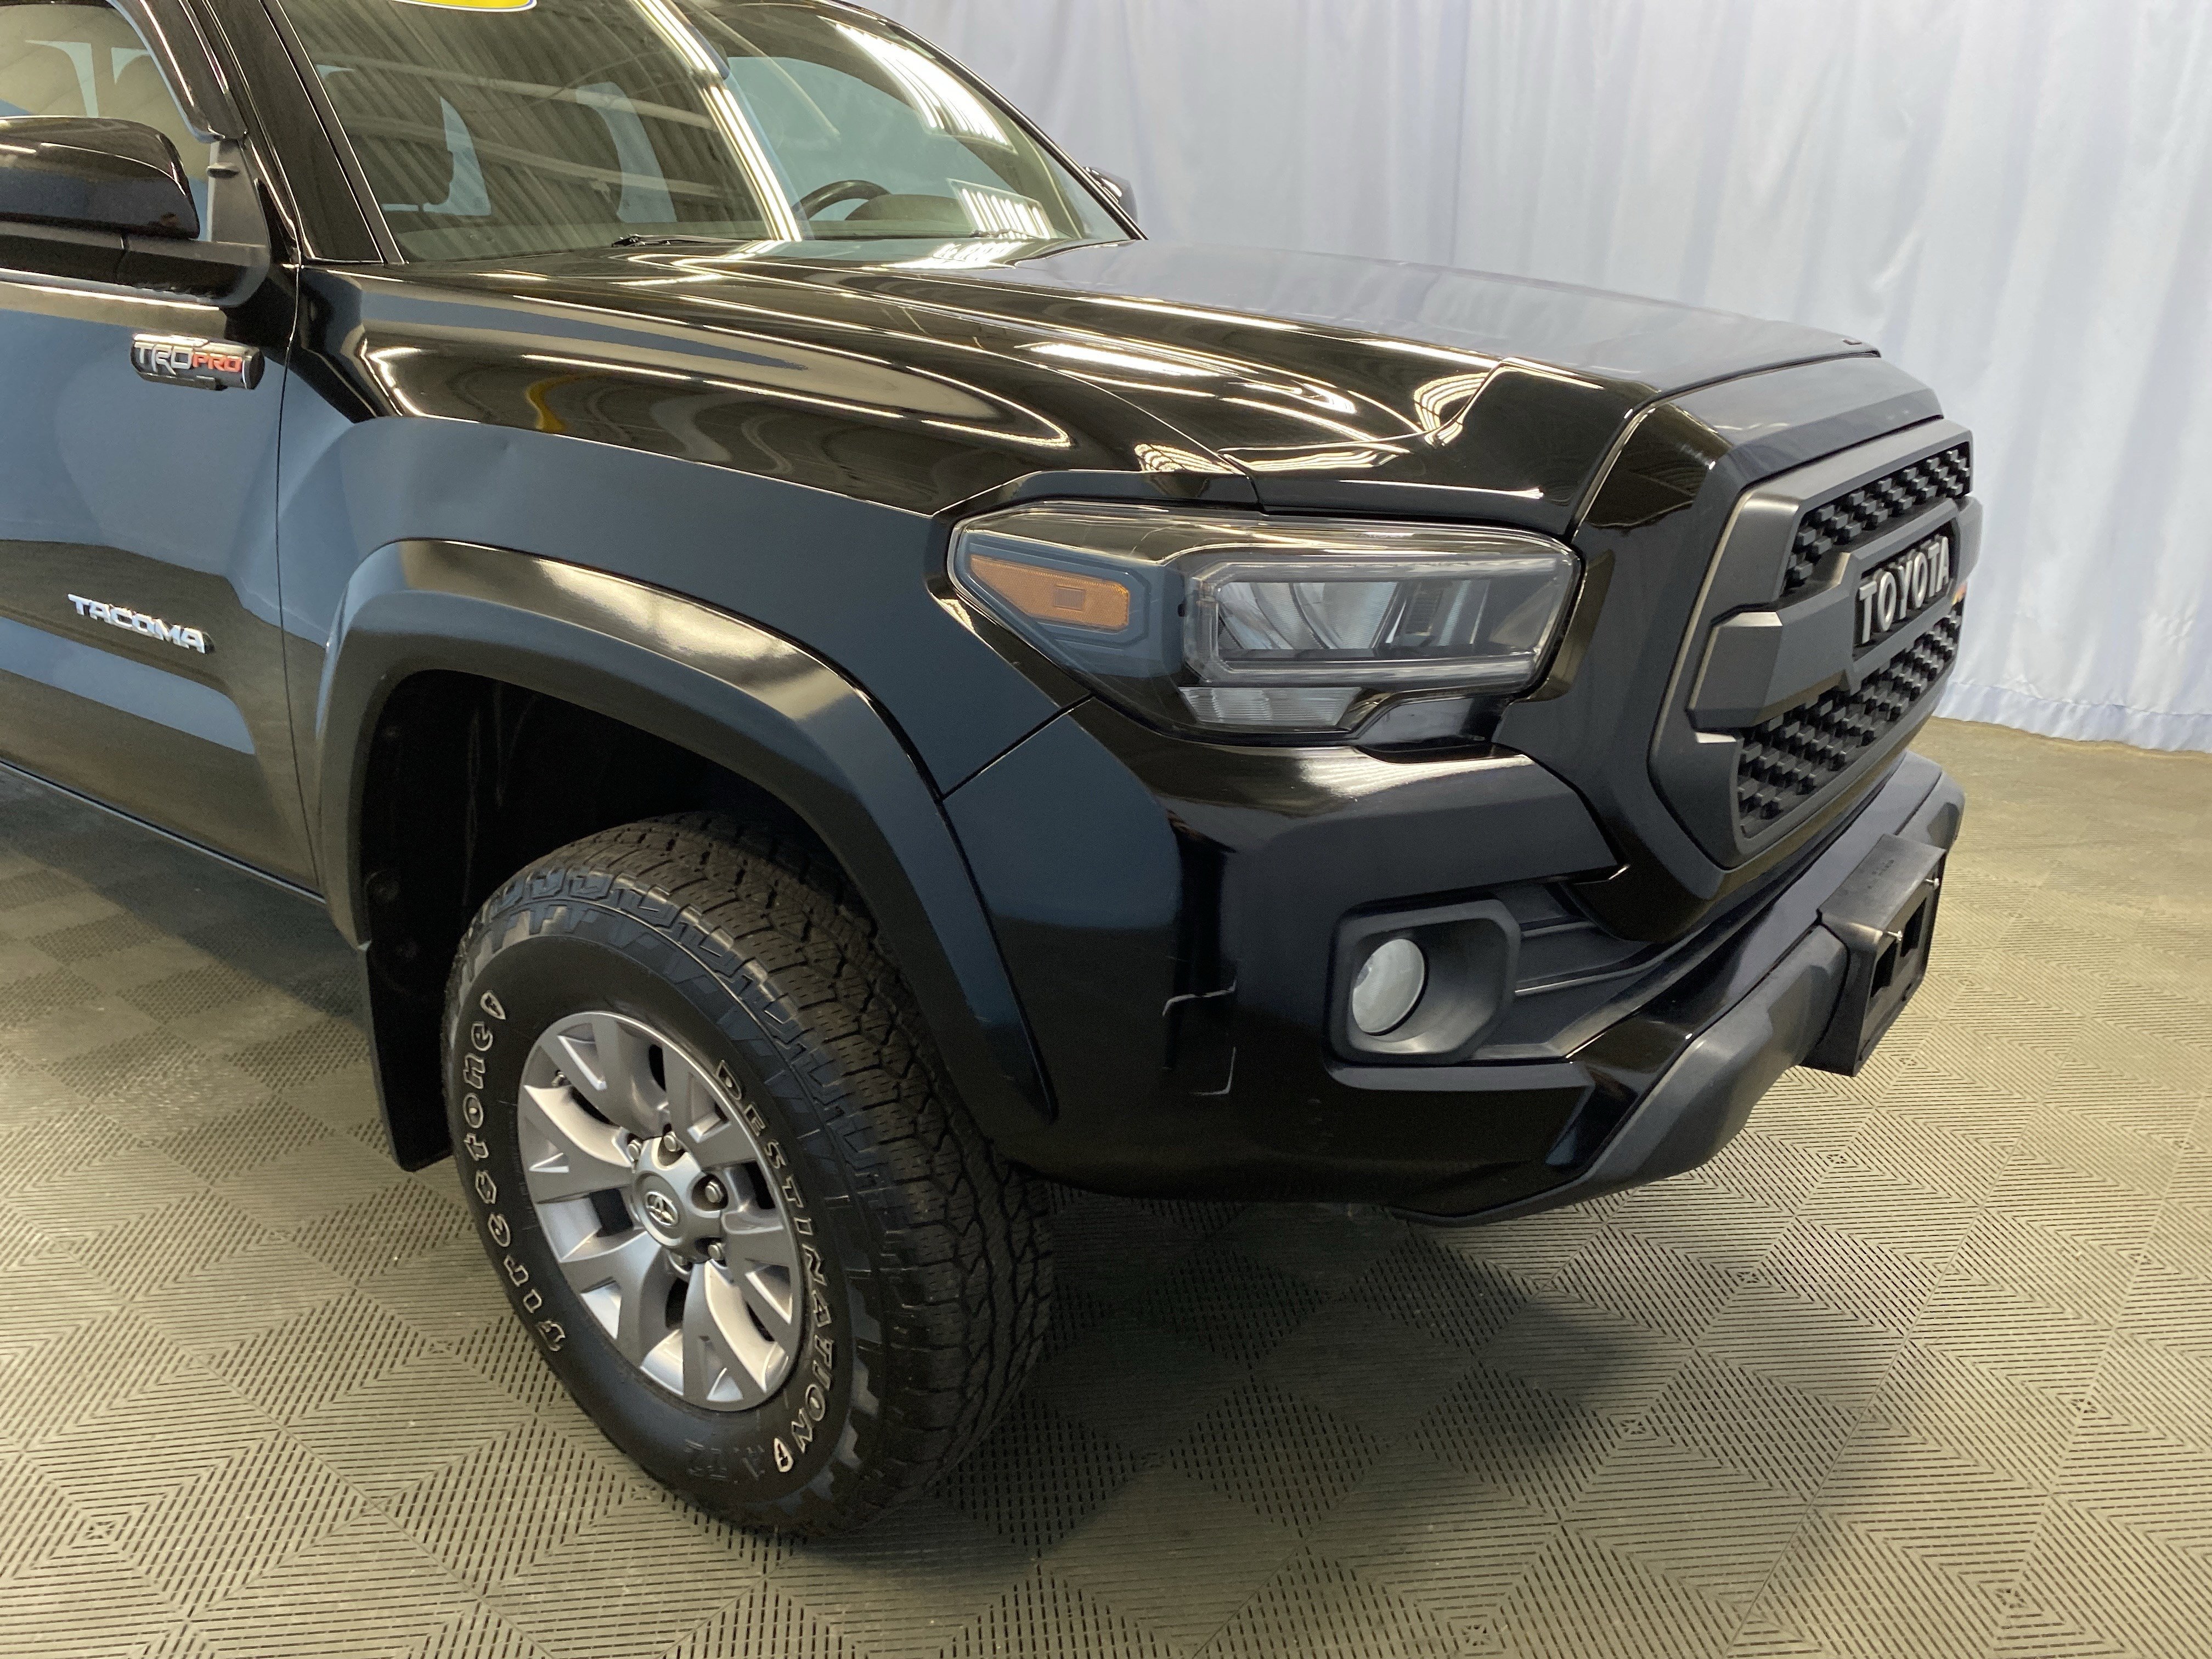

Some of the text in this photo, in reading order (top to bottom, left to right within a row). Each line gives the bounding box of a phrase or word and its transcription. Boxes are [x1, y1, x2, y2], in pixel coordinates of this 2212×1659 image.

[193, 351, 242, 372] PRO
[67, 593, 206, 654] TACOMA
[1859, 535, 1950, 644] TOYOTA
[717, 1059, 834, 1454] DESTINATION
